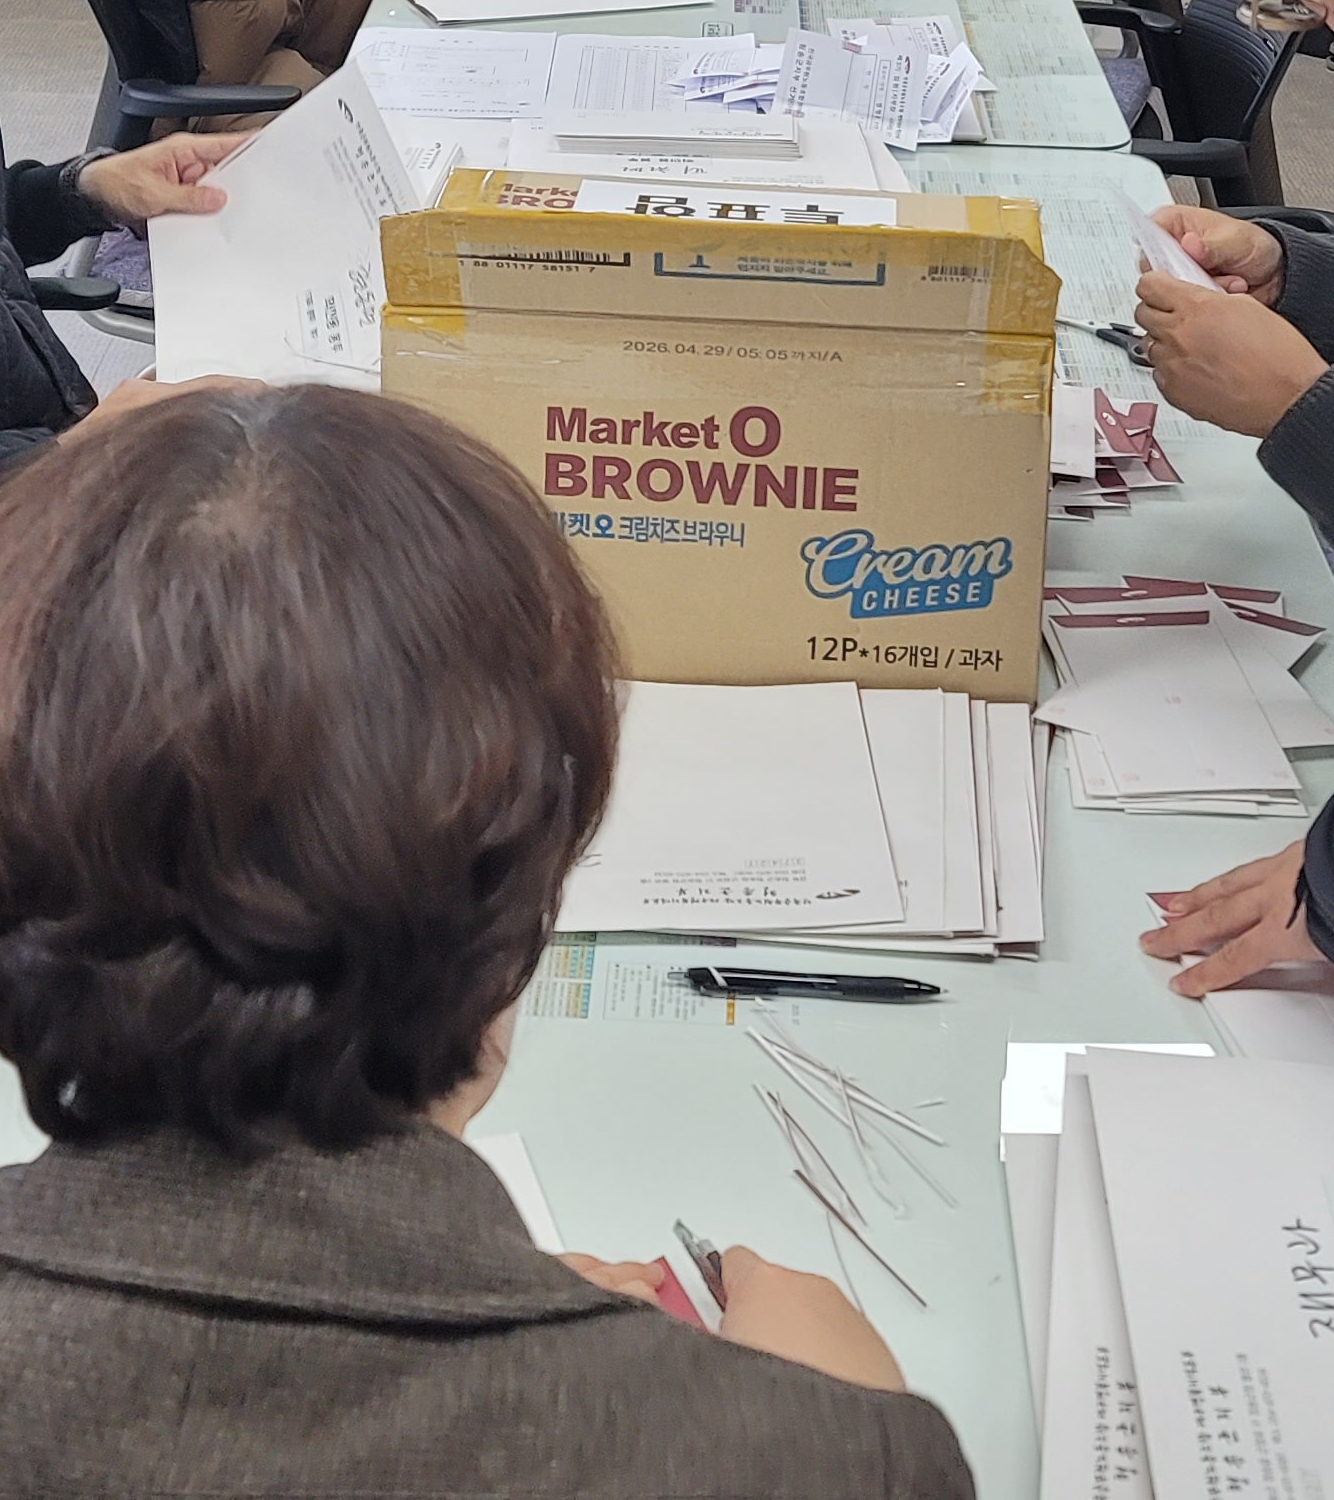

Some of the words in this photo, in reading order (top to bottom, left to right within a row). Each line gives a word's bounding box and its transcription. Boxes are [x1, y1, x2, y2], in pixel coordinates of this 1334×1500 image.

[473, 260, 489, 268] 88
[496, 261, 534, 271] 01117
[587, 266, 596, 274] 7
[546, 406, 720, 450] Market
[729, 406, 781, 458] O
[544, 452, 860, 512] BROWNIE
[618, 516, 746, 548] 크림치즈브라우니
[802, 531, 1009, 596] Cream
[862, 581, 983, 611] CHEESE
[958, 648, 1004, 672] 과자
